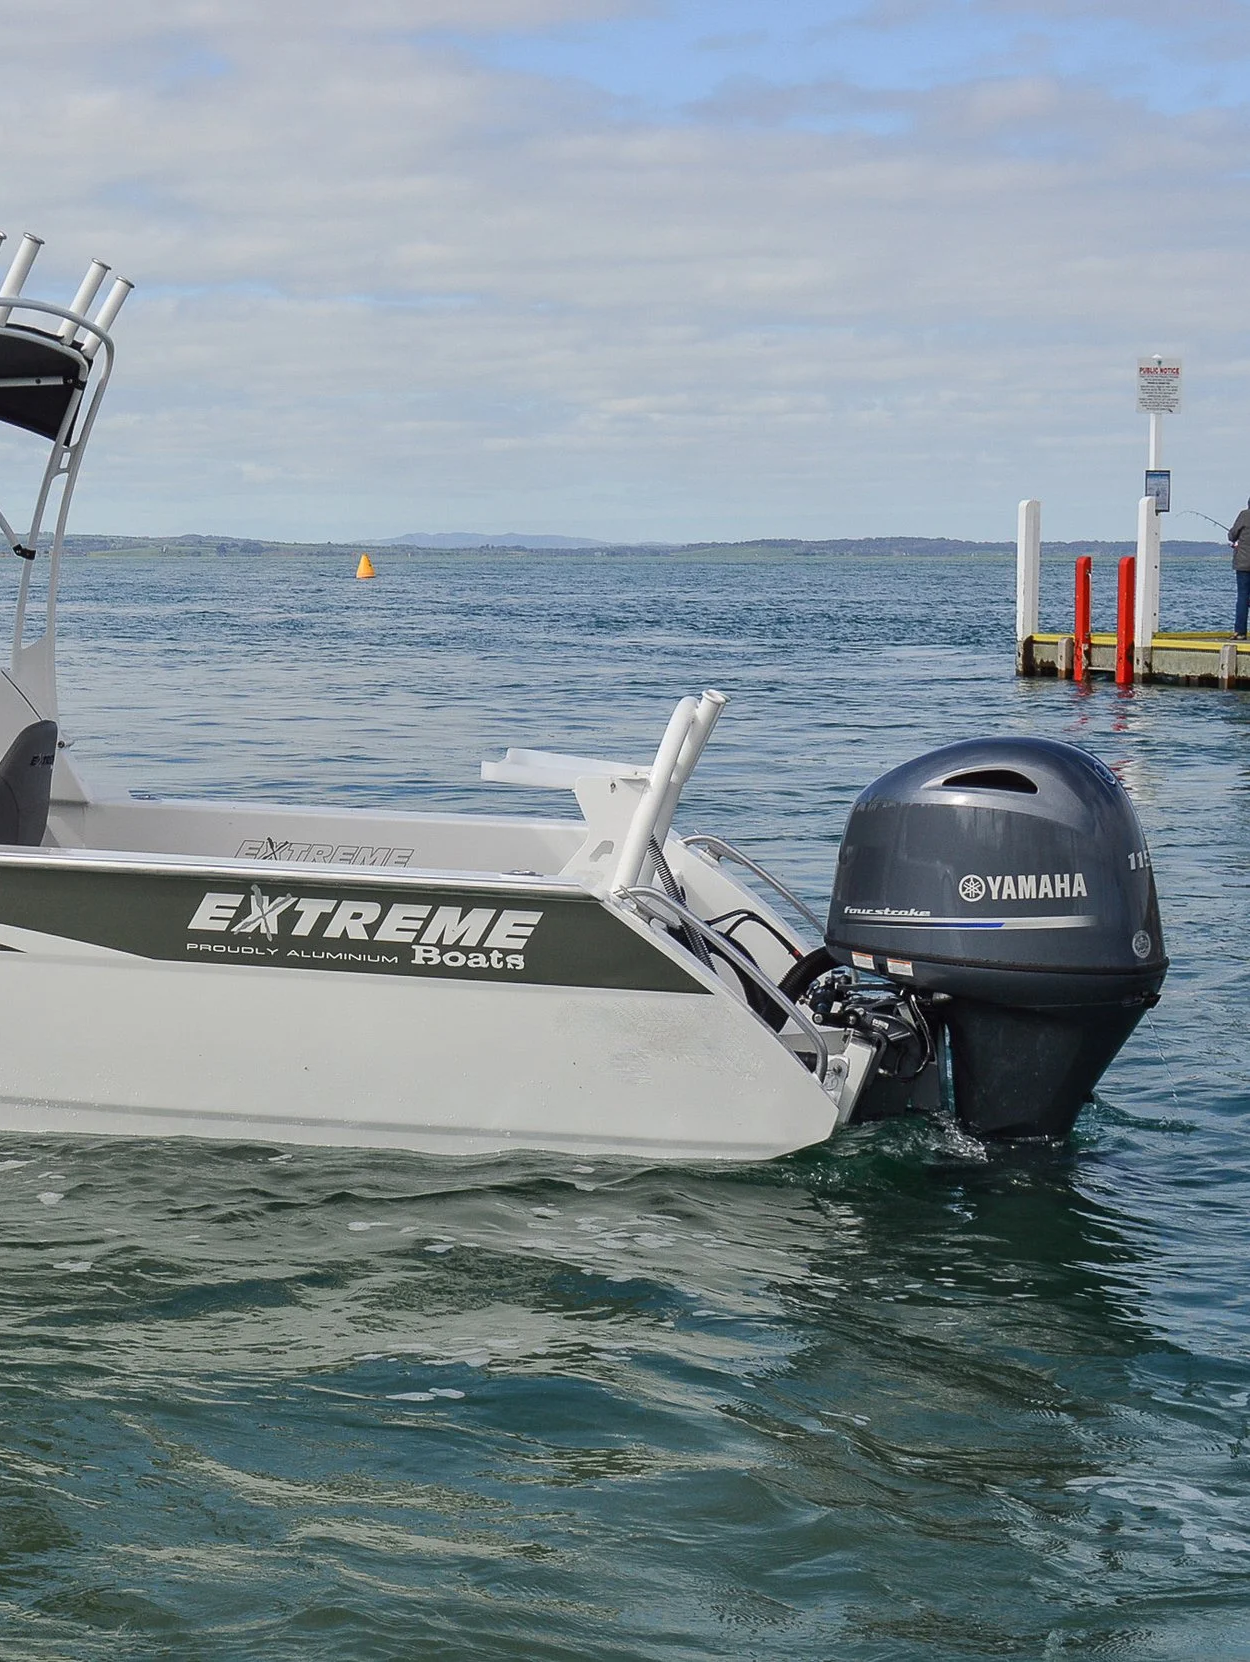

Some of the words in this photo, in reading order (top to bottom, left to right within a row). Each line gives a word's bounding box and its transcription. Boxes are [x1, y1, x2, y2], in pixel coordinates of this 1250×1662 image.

[1139, 367, 1159, 375] PUBLIC
[1160, 367, 1180, 375] NOTICE
[234, 836, 415, 868] EXTREME
[986, 873, 1088, 900] YAMAHA
[187, 884, 544, 950] EXTREME
[186, 943, 279, 956] PROUDLY
[286, 949, 399, 964] ALUMINIUM
[410, 944, 526, 970] Boats
